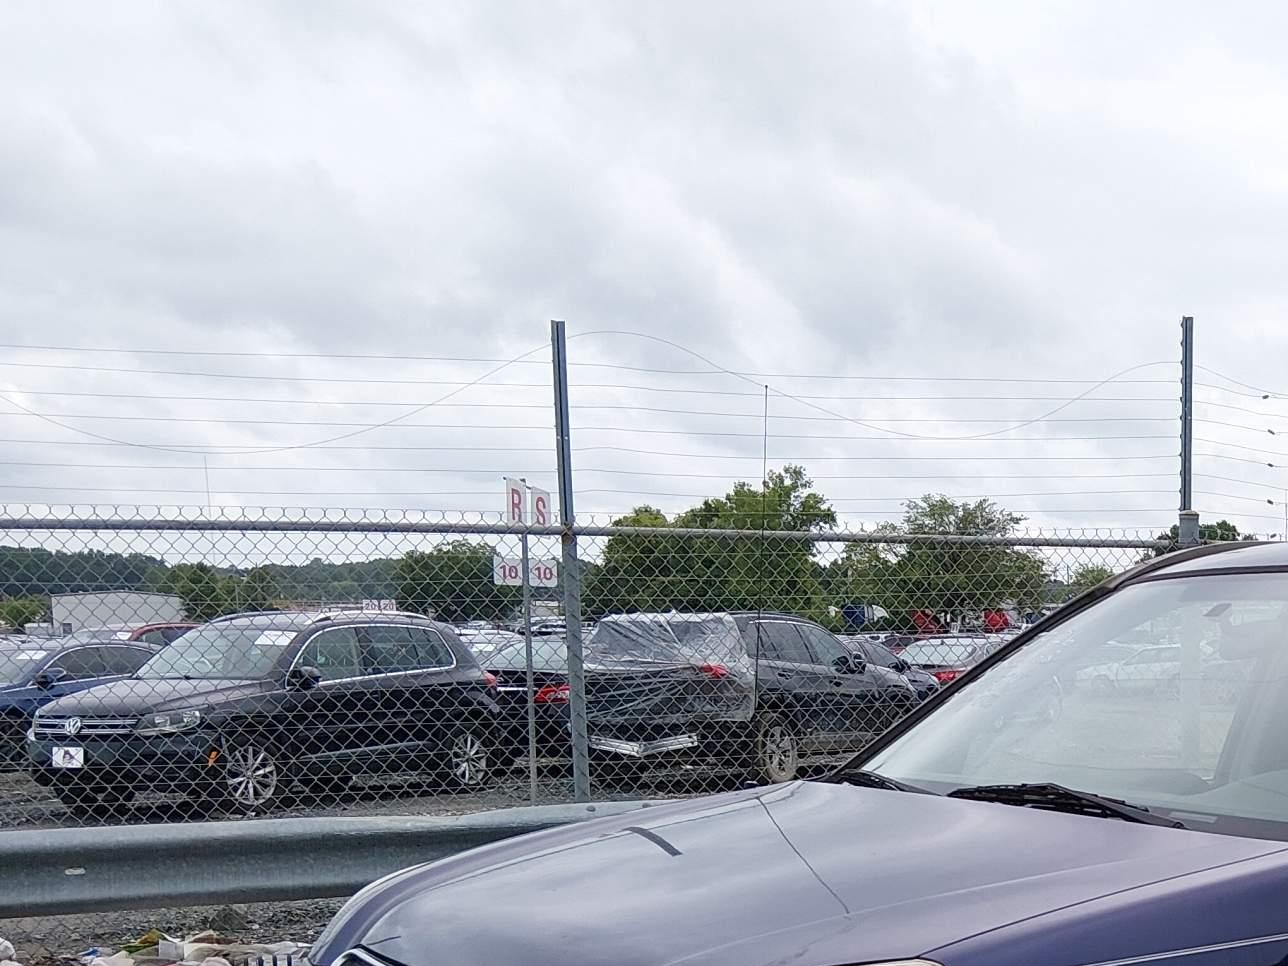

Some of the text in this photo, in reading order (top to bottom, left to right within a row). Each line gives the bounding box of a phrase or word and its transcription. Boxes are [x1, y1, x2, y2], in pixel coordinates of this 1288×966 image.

[510, 487, 523, 522] R
[535, 496, 547, 527] S
[500, 565, 519, 580] 10
[534, 566, 554, 581] 10
